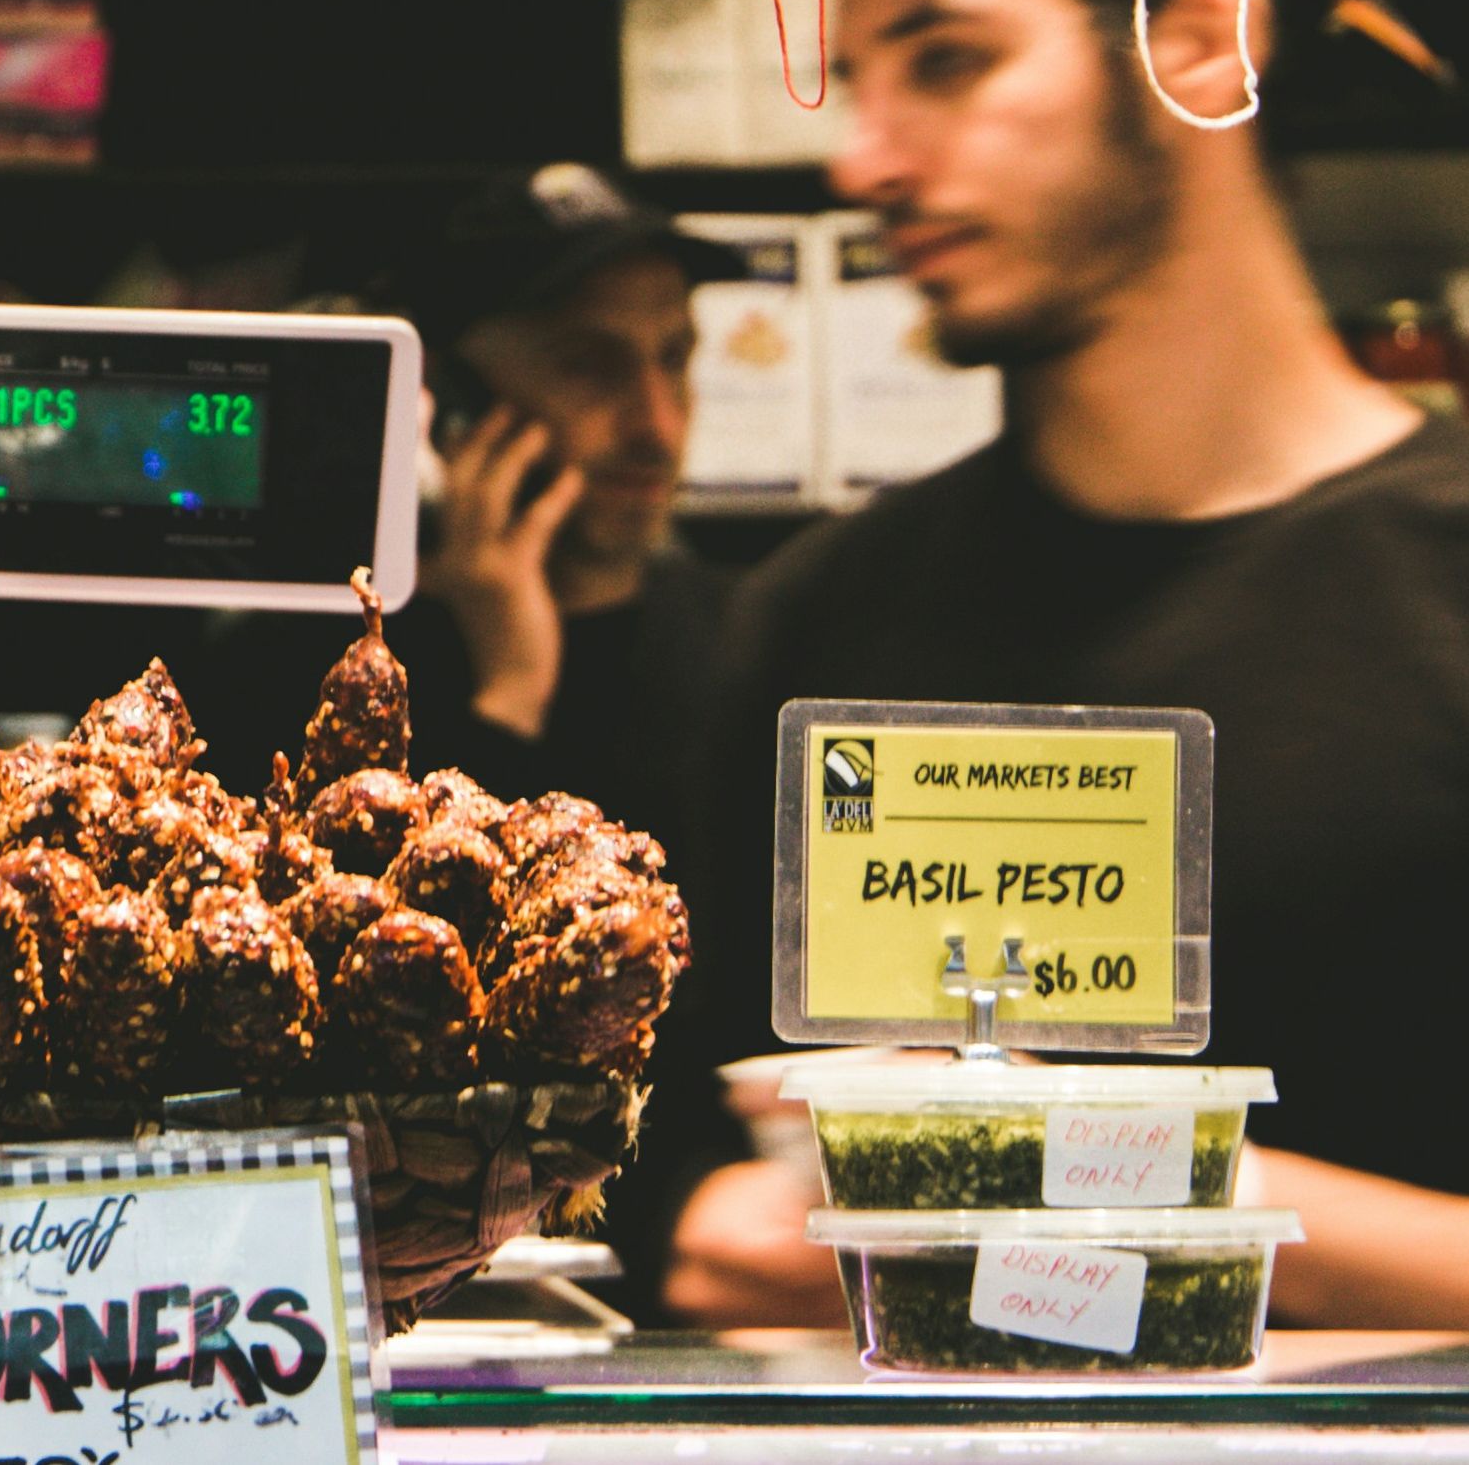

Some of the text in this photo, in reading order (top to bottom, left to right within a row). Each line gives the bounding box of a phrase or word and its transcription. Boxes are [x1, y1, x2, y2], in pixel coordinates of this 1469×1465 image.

[914, 763, 1138, 791] OUR MARKETS BEST
[861, 859, 1125, 908] BASIL PESTO
[1035, 952, 1137, 997] $6.00
[1065, 1118, 1174, 1154] DISPLAY
[1065, 1160, 1154, 1195] ONLY
[1001, 1244, 1120, 1293] DISPLAY
[1000, 1292, 1091, 1327] ONLY
